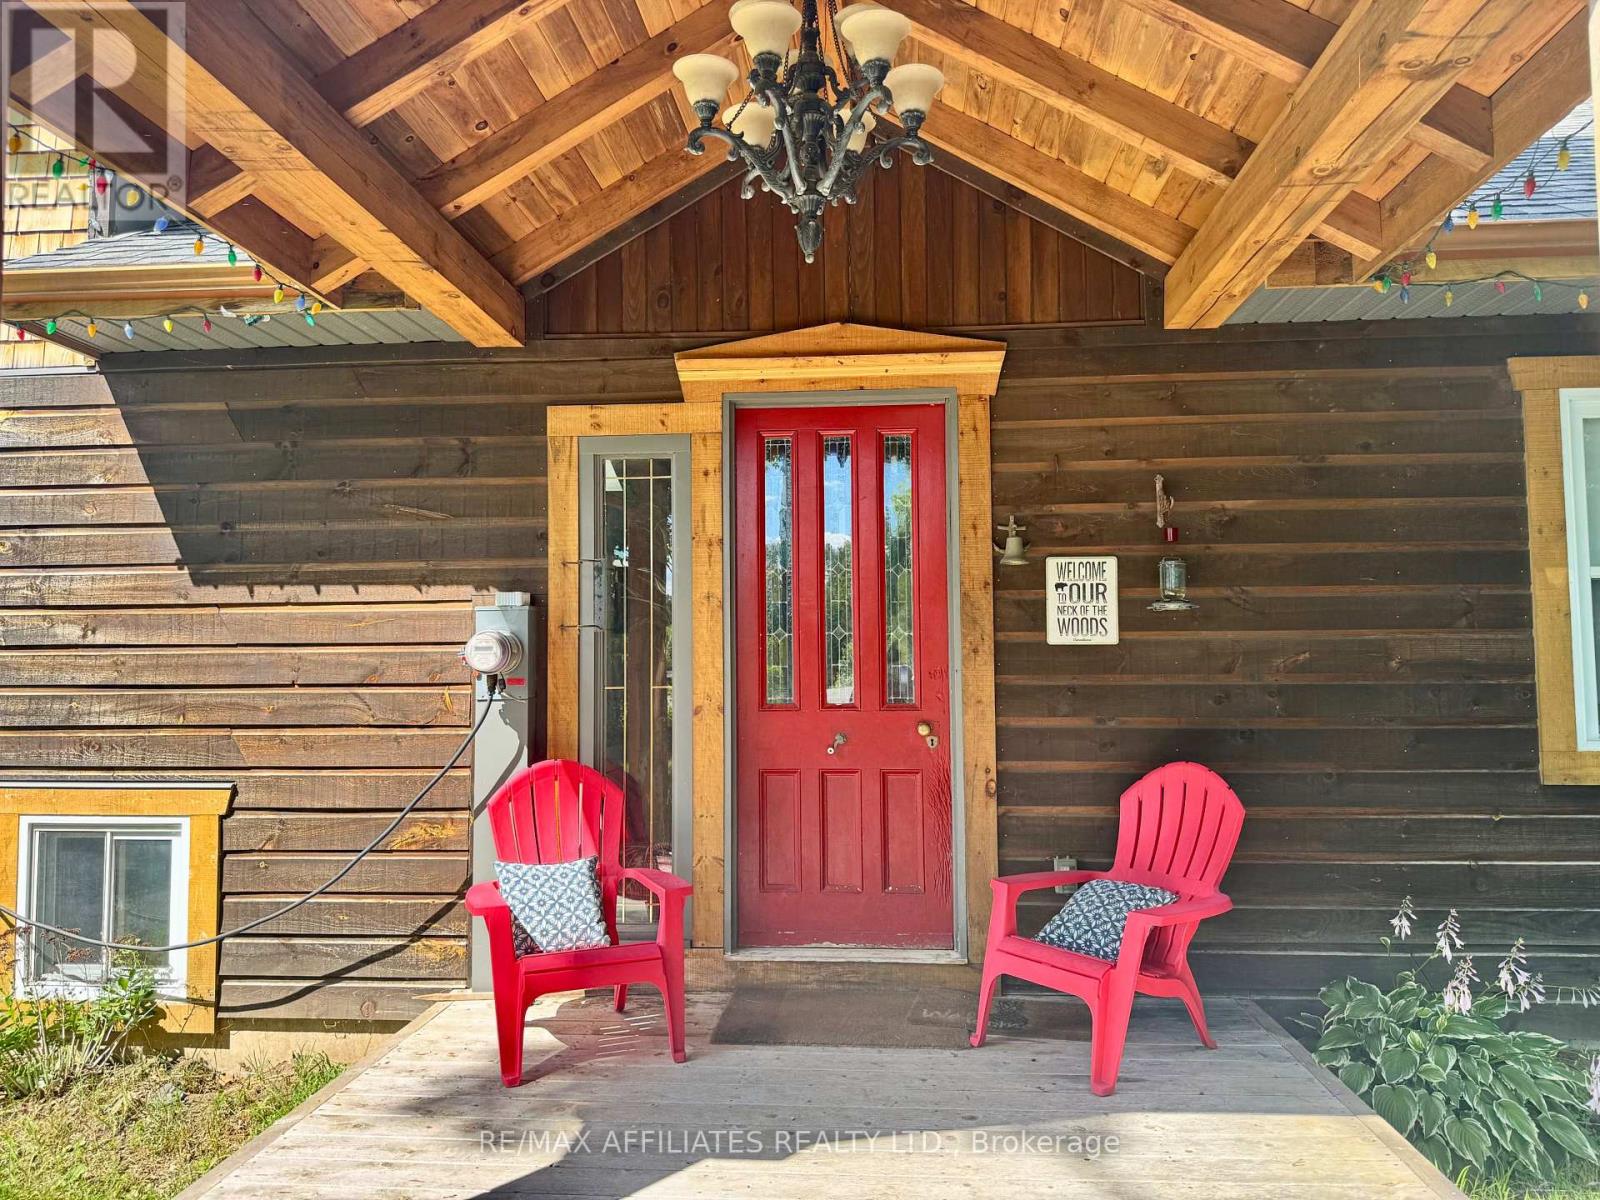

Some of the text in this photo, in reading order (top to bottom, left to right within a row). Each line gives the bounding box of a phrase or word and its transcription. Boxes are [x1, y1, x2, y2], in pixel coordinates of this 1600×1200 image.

[1056, 561, 1107, 581] WELCOME
[1057, 582, 1108, 604] TO OUR
[1057, 605, 1107, 616] NECK OF THE
[1057, 617, 1108, 637] WOODS
